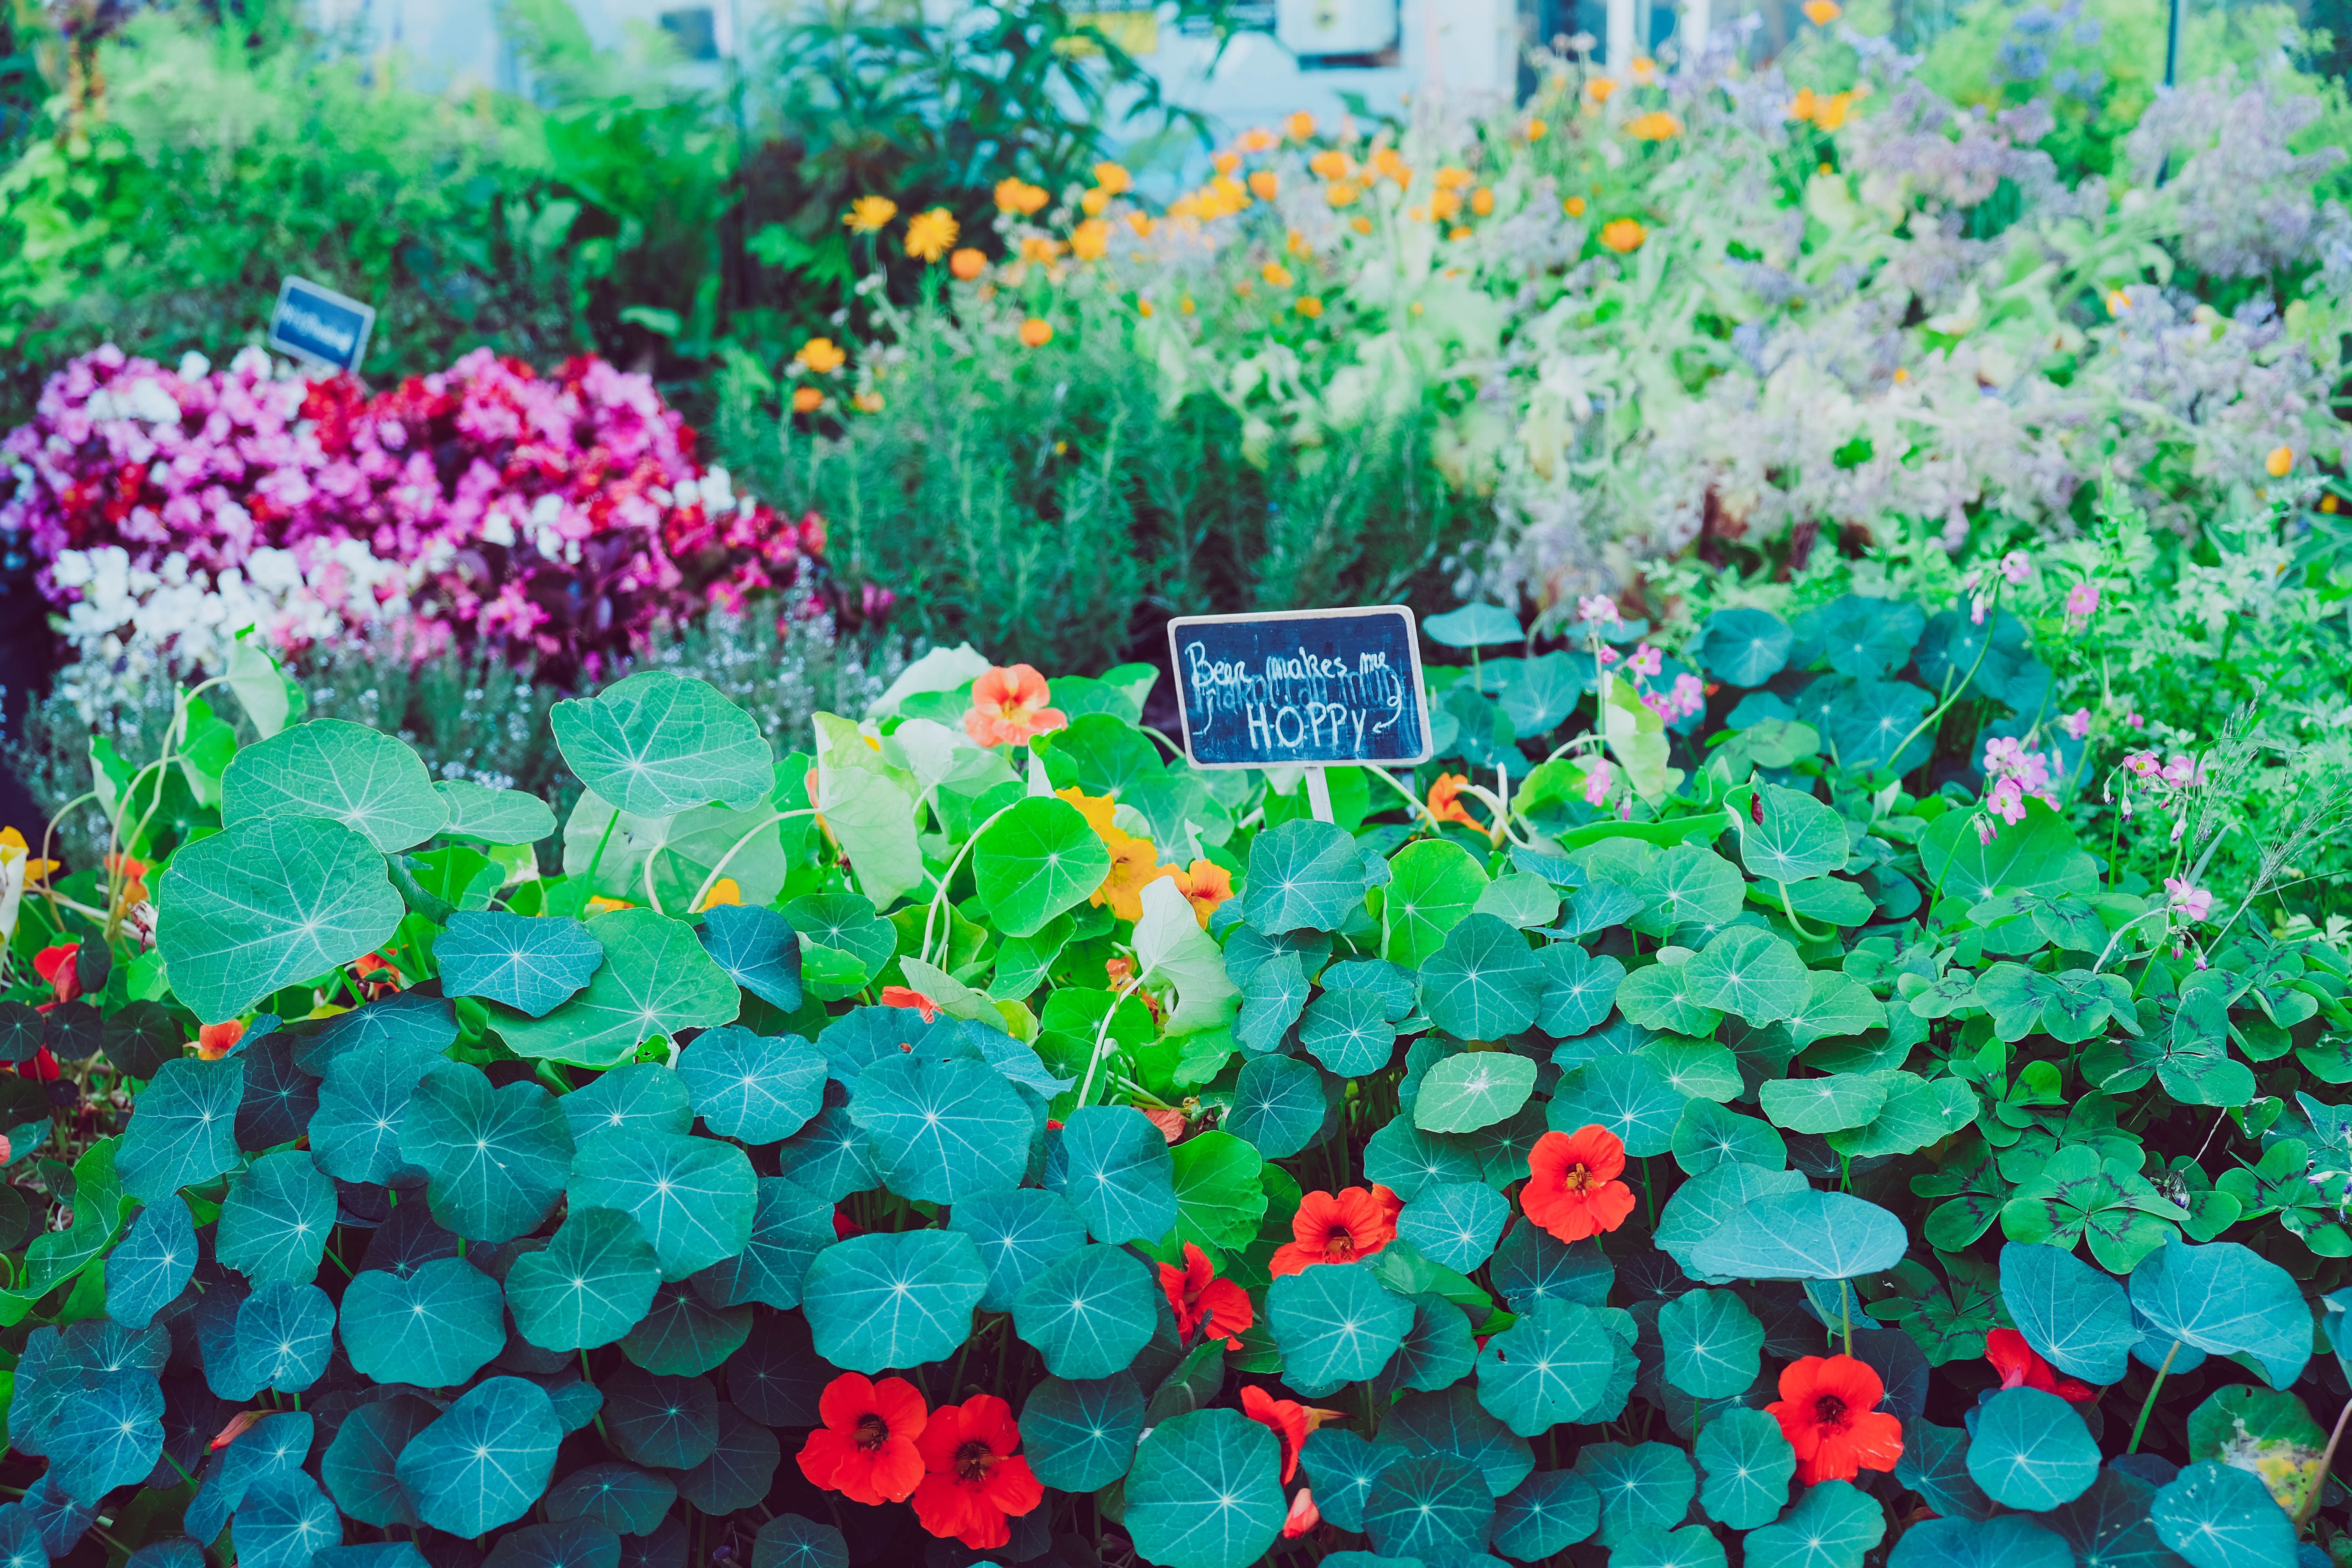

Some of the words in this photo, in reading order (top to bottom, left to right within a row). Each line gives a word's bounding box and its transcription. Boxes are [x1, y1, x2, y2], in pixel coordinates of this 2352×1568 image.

[1185, 641, 1253, 687] Beer
[1266, 646, 1347, 680] makes
[1359, 652, 1389, 675] me
[1247, 701, 1367, 753] HOPPY
